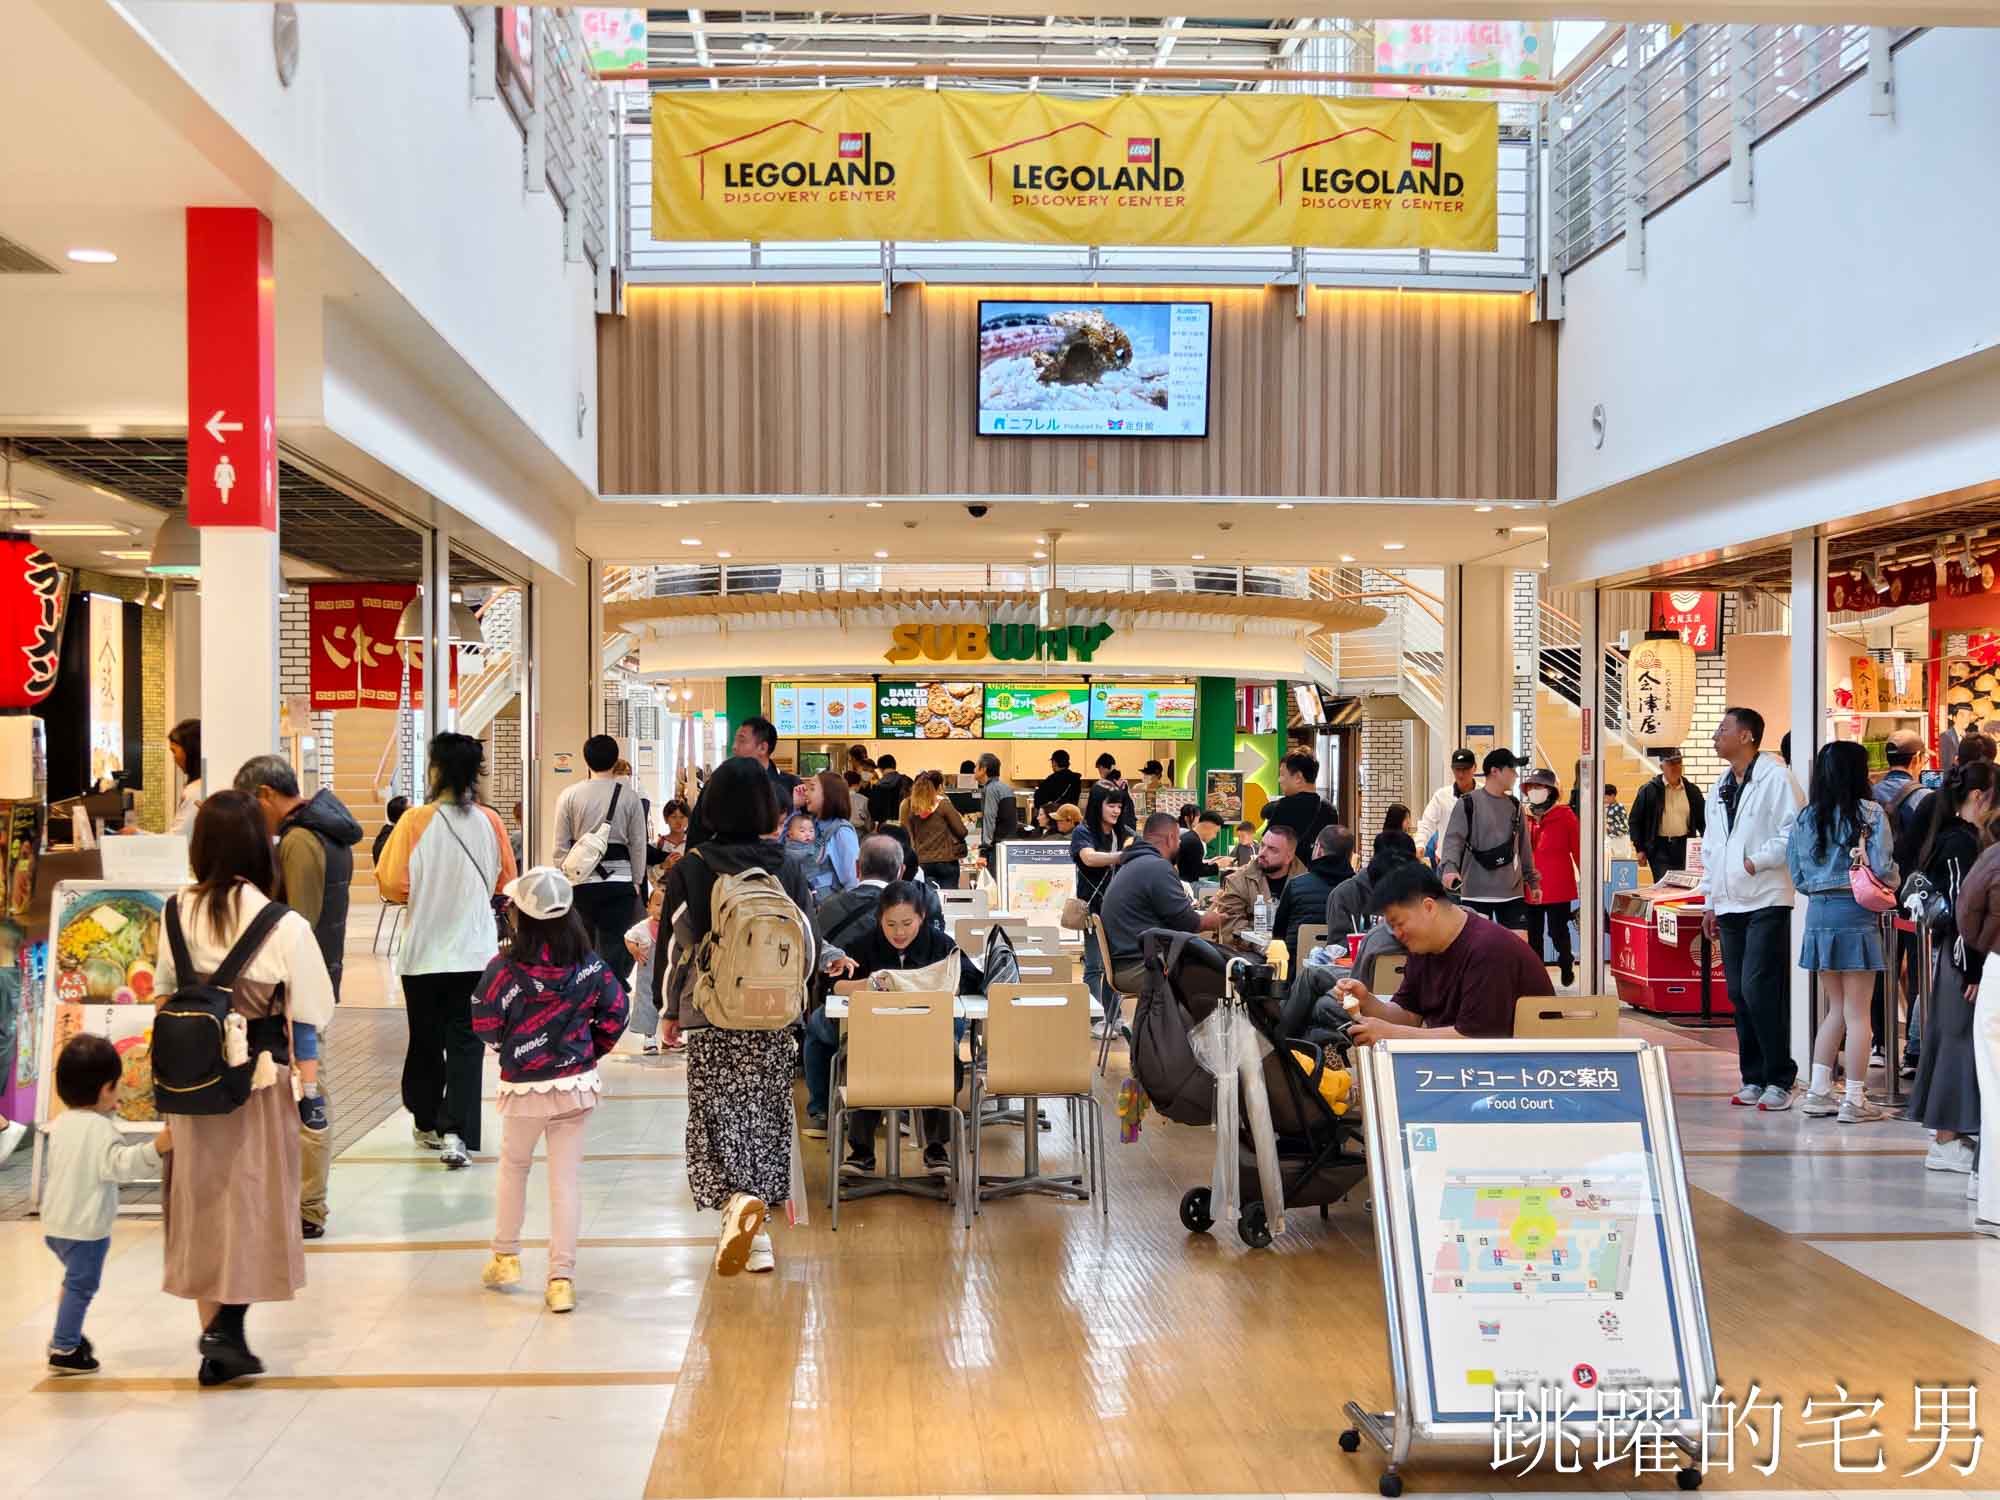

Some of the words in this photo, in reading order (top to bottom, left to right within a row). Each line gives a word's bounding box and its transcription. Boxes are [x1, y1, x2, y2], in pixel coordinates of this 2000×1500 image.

[724, 132, 895, 187] LEGOLAND
[1013, 138, 1184, 191] LEGOLAND
[1302, 143, 1464, 196] LEGOLAND
[724, 191, 820, 203] DISCOVERY
[829, 191, 896, 201] CENTER
[1012, 195, 1109, 206] DISCOVERY
[1118, 196, 1185, 207] CENTER
[1302, 197, 1393, 209] DISCOVERY
[1401, 199, 1464, 212] CENTER
[1009, 417, 1060, 431] ニフレル
[21, 549, 59, 697] ラーメン
[883, 622, 1115, 665] SUBWAY
[1680, 623, 1710, 647] 津屋
[888, 688, 929, 697] BAKED
[1638, 671, 1661, 735] 会津屋
[513, 1032, 548, 1058] ADIDAS
[1415, 1067, 1618, 1088] フードコートのご案内
[1487, 1097, 1516, 1110] Food
[1520, 1097, 1555, 1110] Court
[1415, 1131, 1433, 1149] 2F
